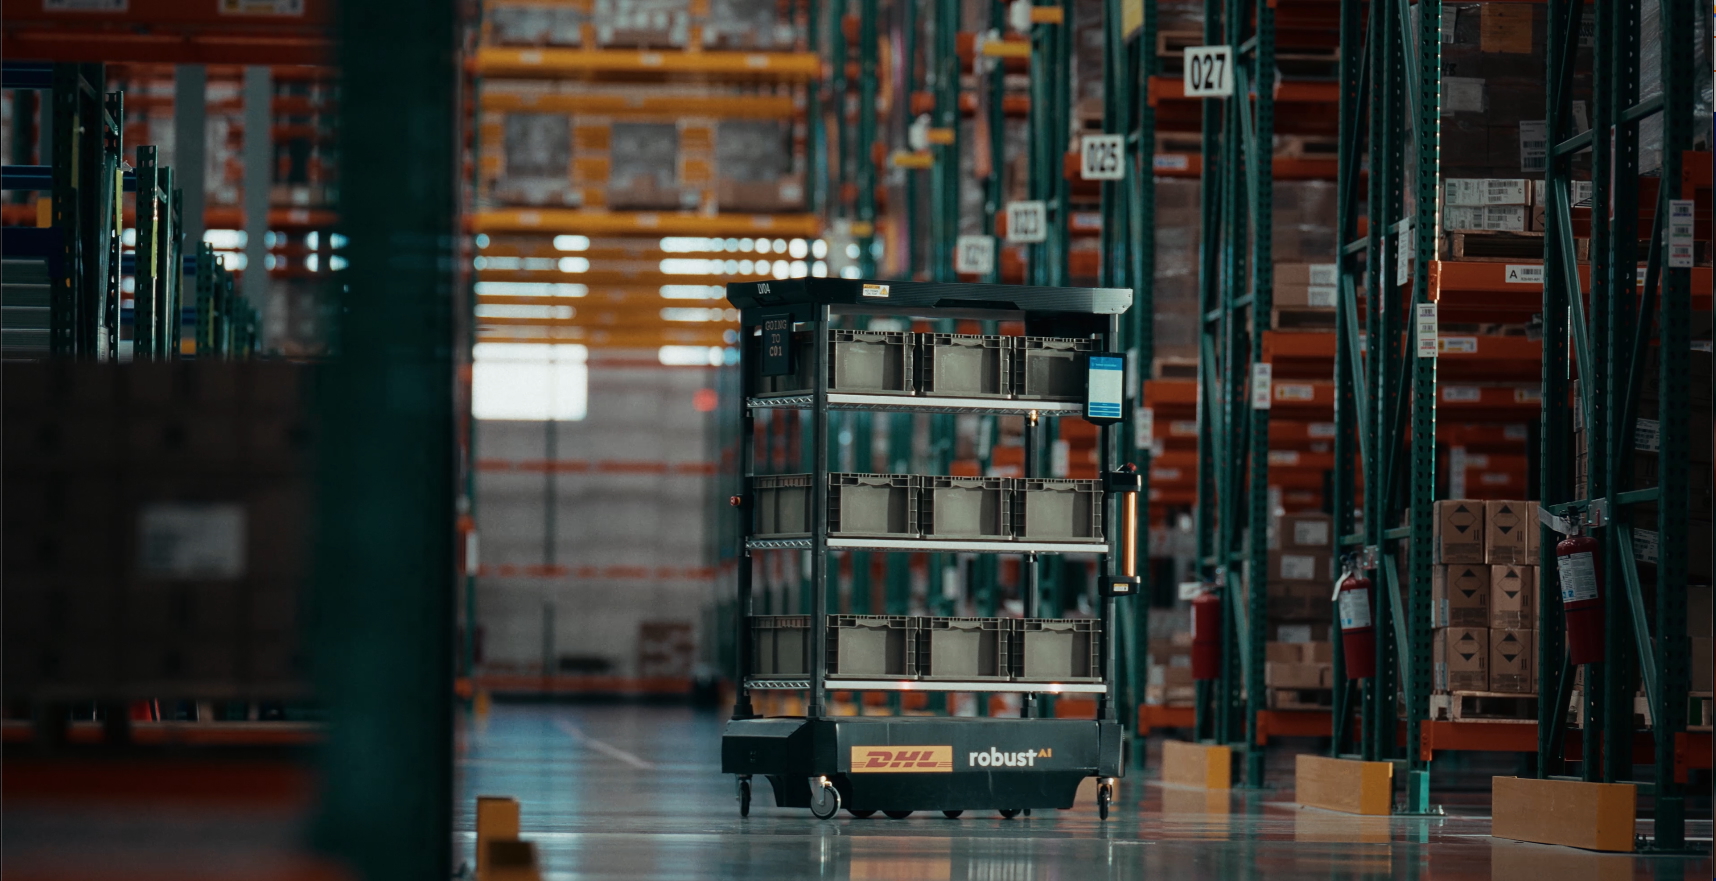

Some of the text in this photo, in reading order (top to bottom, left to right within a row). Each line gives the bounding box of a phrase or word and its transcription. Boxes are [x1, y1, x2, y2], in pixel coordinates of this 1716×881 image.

[1190, 54, 1226, 90] 027
[1086, 142, 1118, 173] 025
[1509, 269, 1518, 279] A
[765, 319, 787, 331] GOING
[771, 333, 781, 344] TO
[769, 346, 782, 357] C01
[865, 750, 939, 768] DHL
[969, 747, 1052, 766] robust AI
